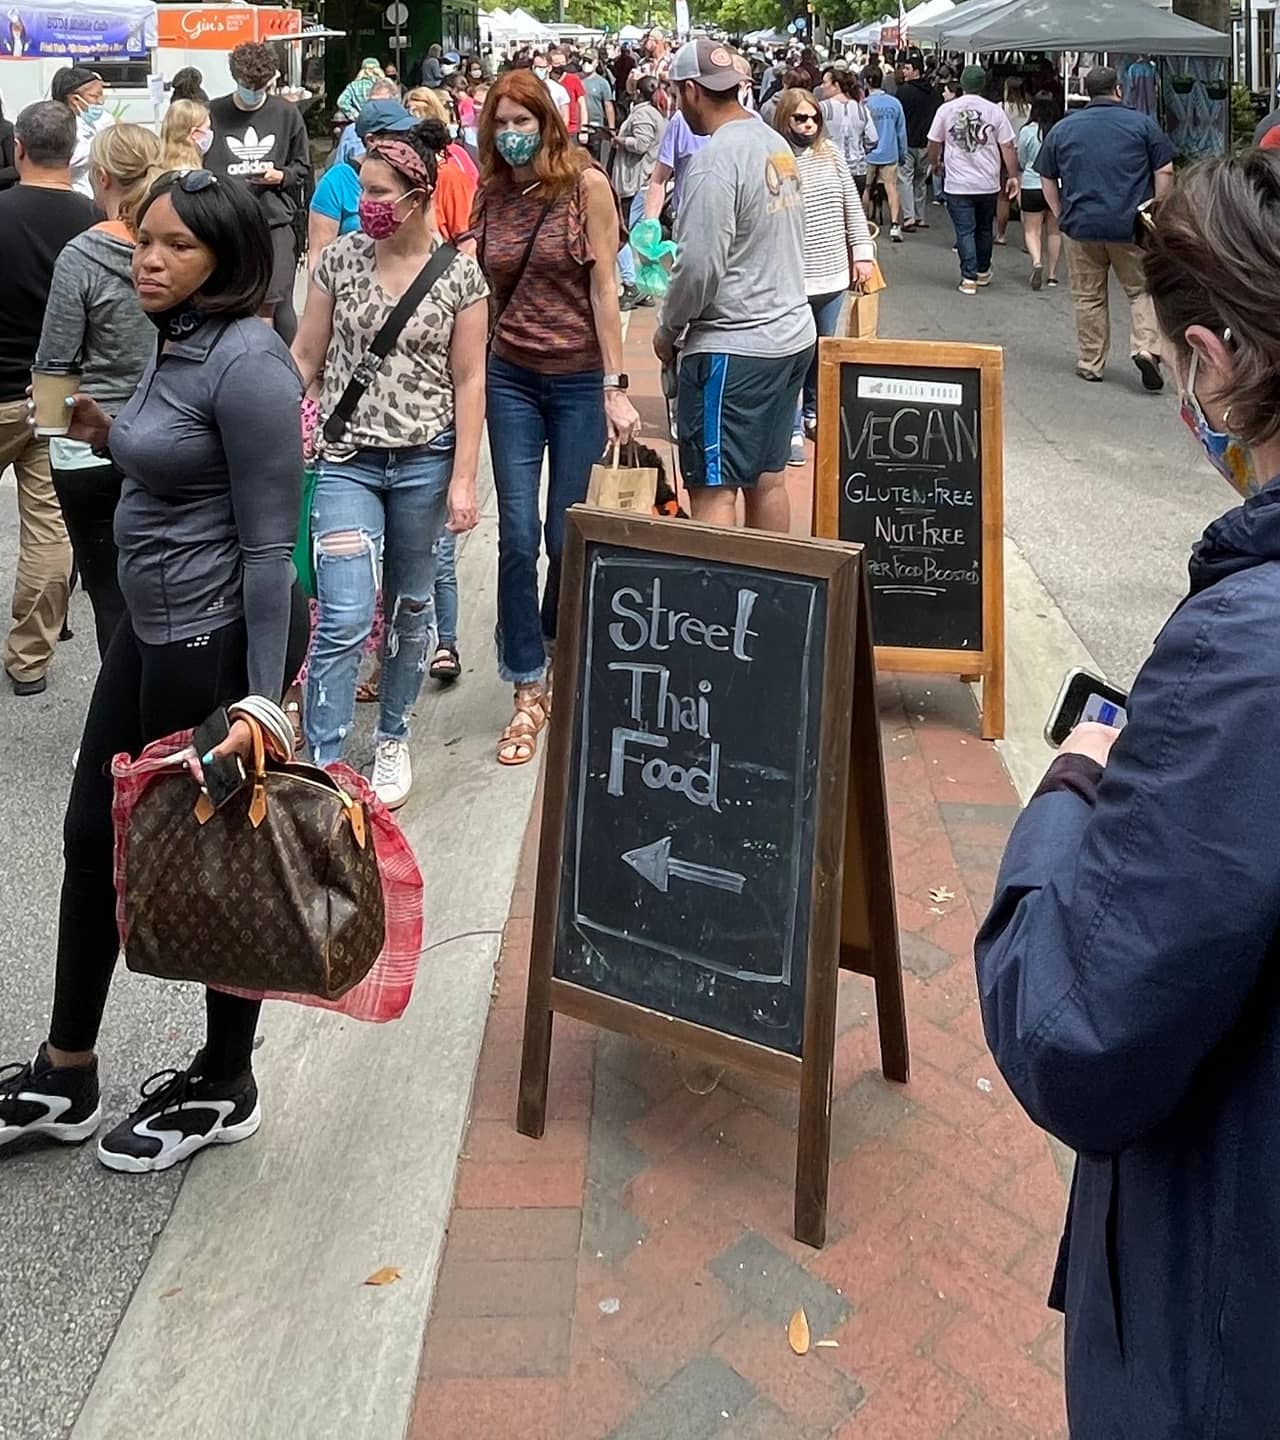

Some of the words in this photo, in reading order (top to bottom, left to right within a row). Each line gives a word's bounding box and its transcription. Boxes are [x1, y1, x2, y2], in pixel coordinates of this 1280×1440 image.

[181, 10, 225, 39] Gin's
[840, 405, 979, 463] VEGAN
[844, 472, 974, 507] GLUTEN-FREE
[875, 515, 966, 546] NUT-FREE
[608, 577, 759, 661] Street
[607, 661, 713, 739] Thai
[607, 726, 722, 814] Food
